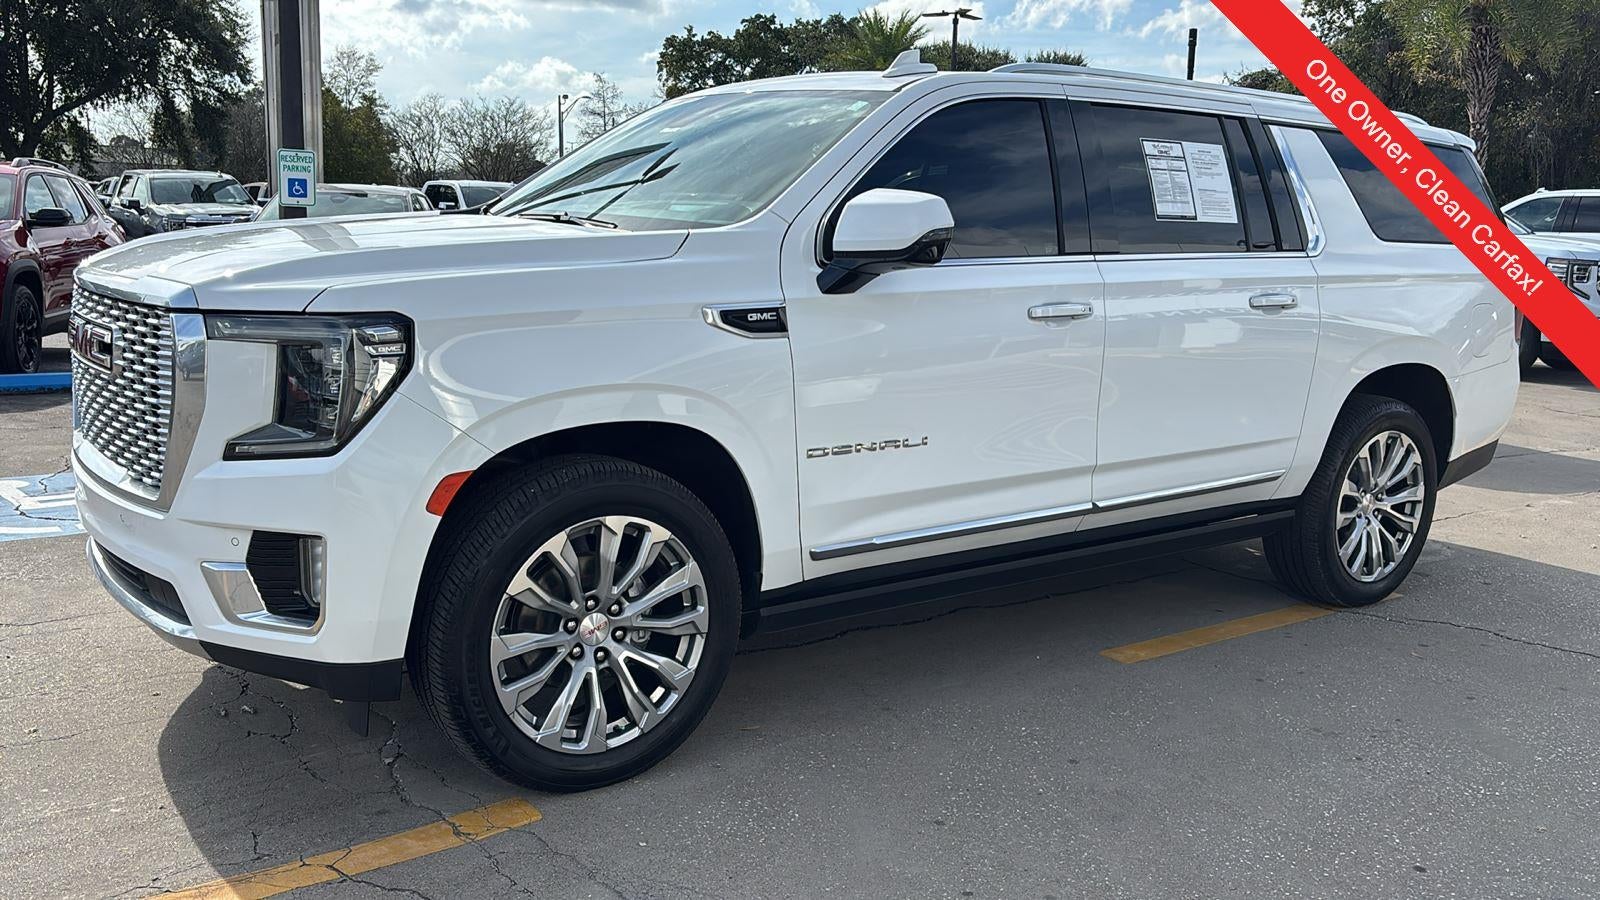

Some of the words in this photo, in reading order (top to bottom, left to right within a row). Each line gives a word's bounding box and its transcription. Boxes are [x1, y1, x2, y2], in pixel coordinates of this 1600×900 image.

[280, 154, 313, 164] RESERVED
[282, 164, 312, 173] PARKING
[747, 312, 777, 321] GMC
[807, 436, 928, 459] DENALI
